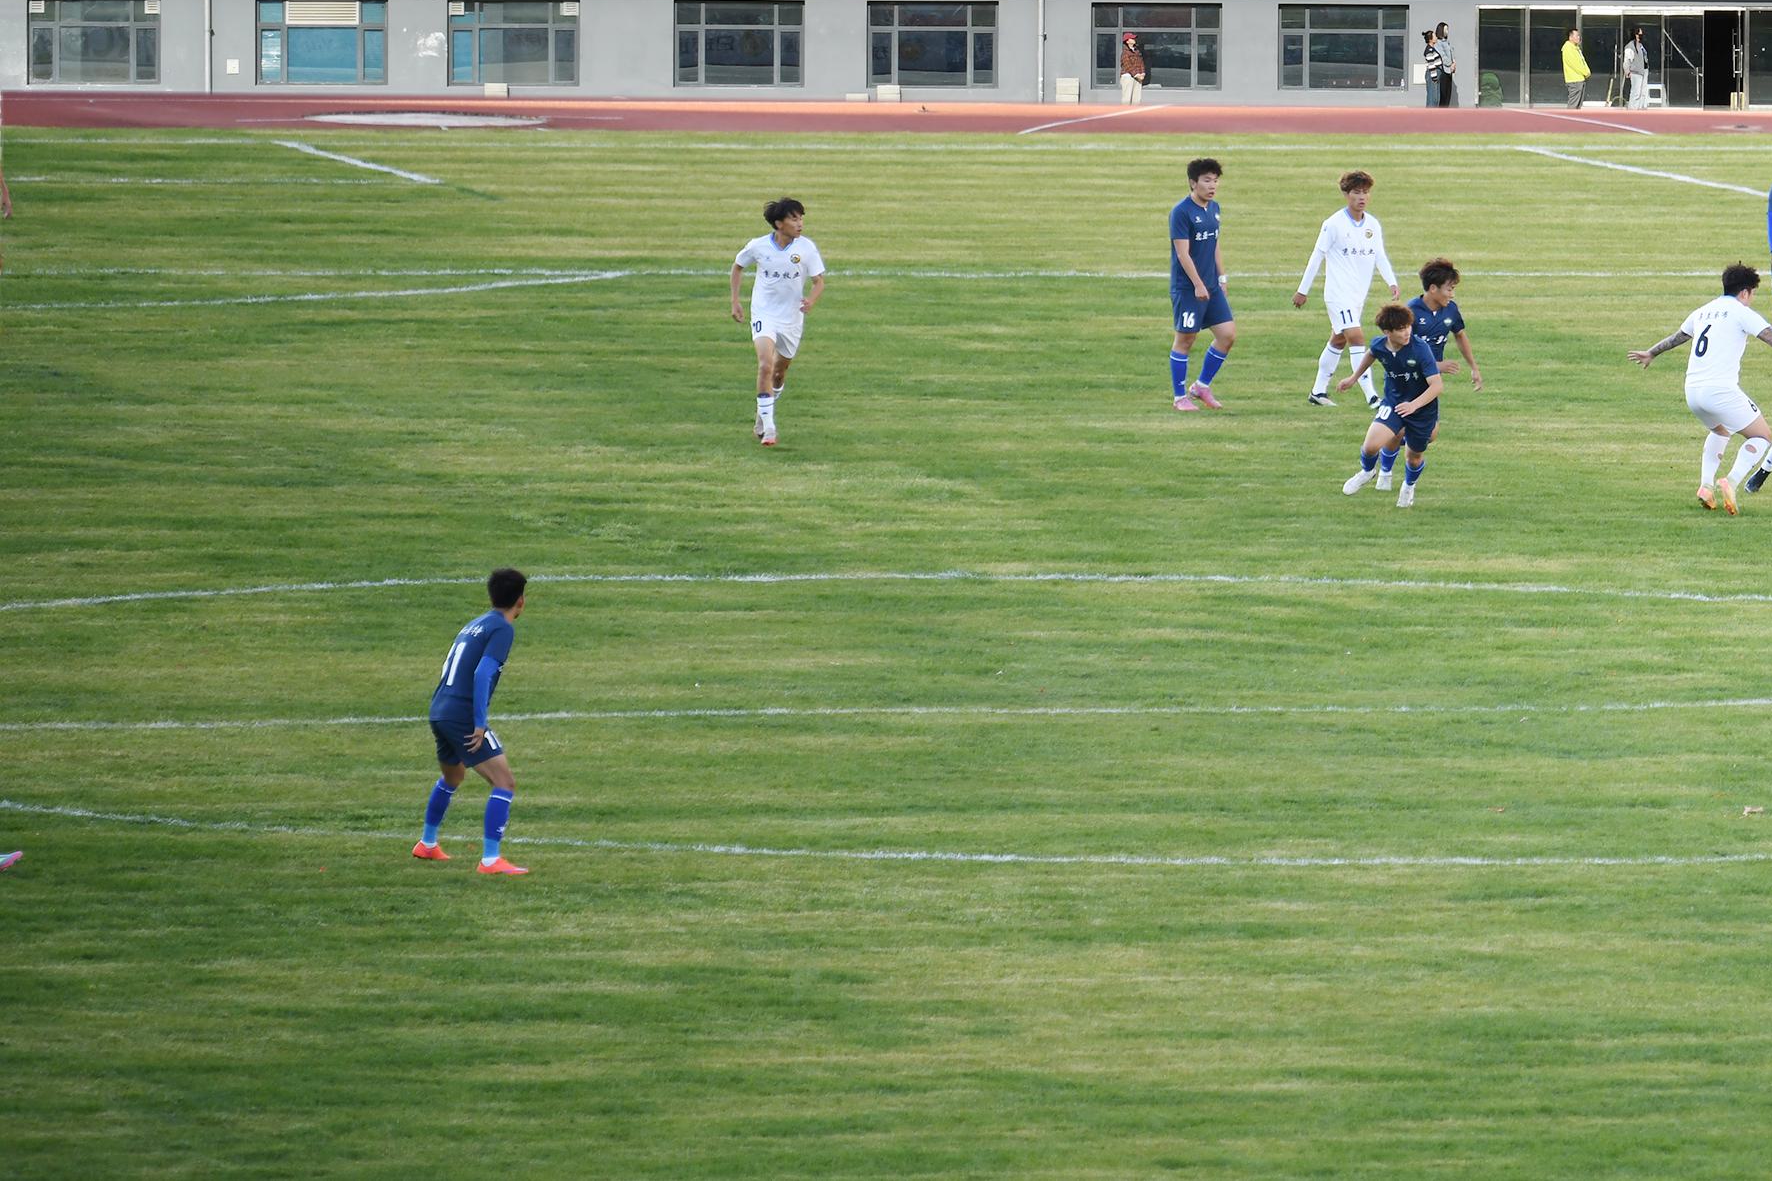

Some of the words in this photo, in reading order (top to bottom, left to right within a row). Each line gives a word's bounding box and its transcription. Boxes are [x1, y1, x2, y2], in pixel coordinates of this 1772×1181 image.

[1182, 312, 1196, 329] 16
[1340, 309, 1354, 325] 11
[752, 320, 762, 334] 0
[1694, 324, 1713, 358] 6
